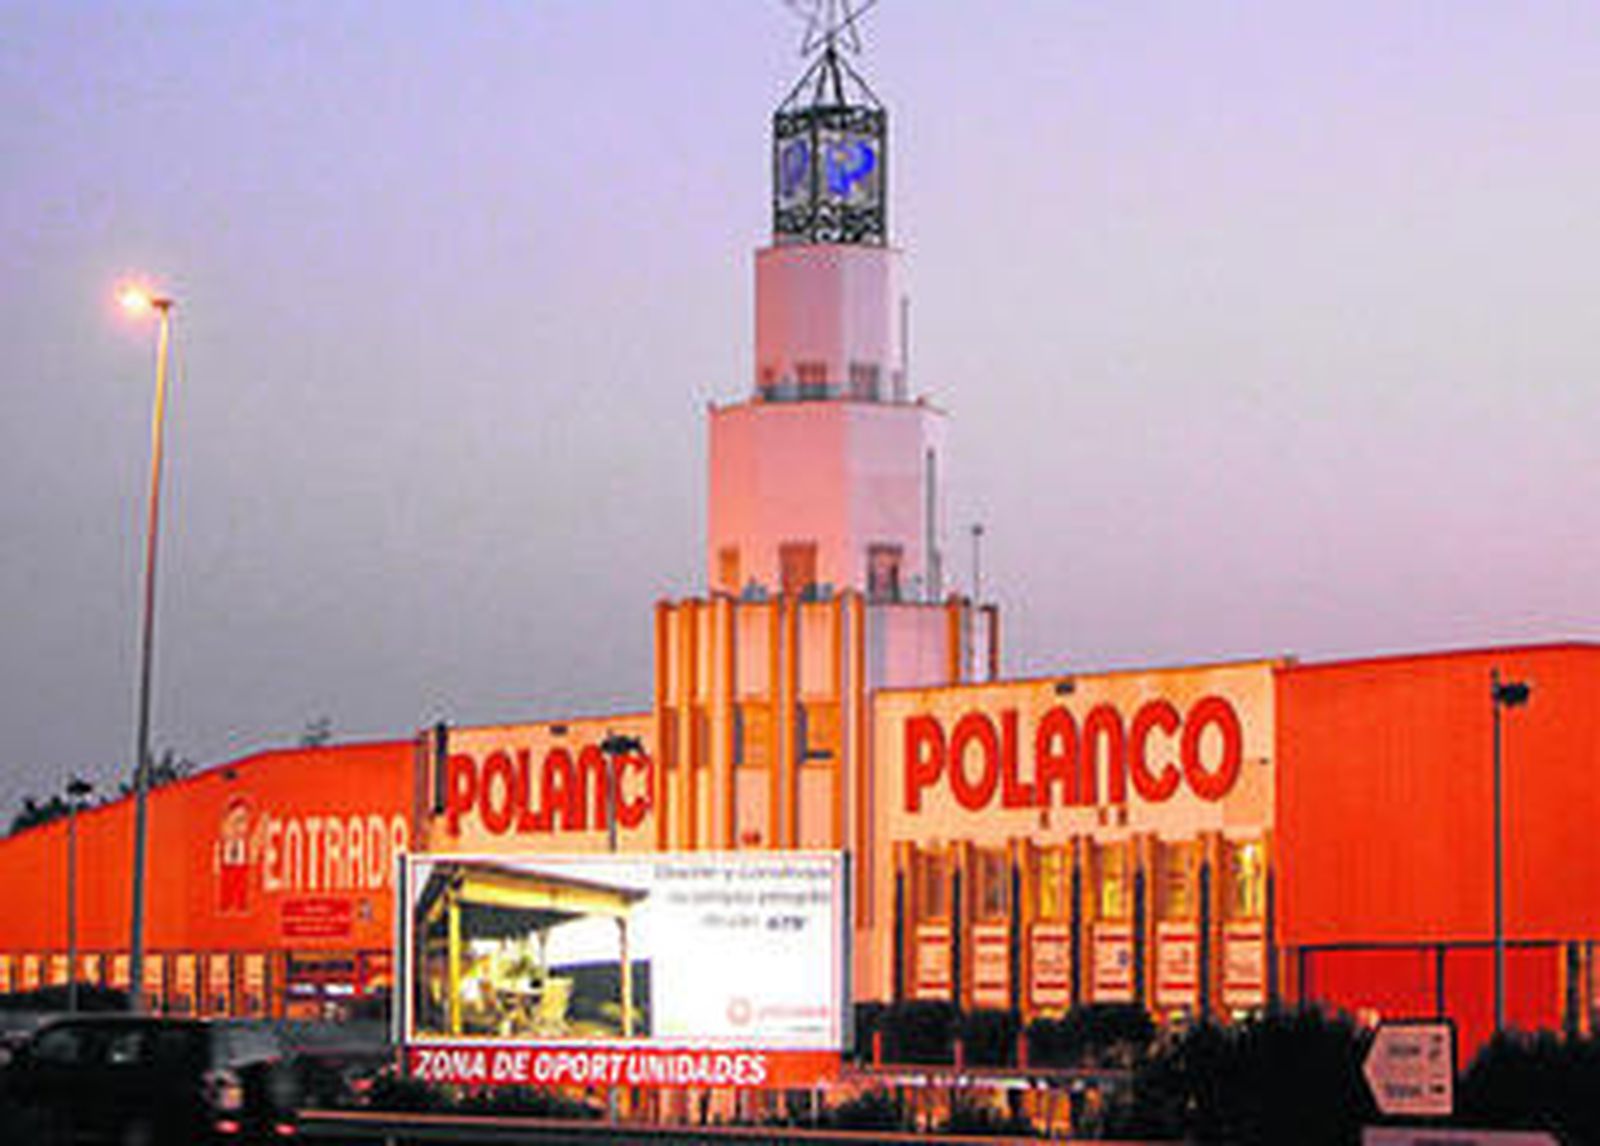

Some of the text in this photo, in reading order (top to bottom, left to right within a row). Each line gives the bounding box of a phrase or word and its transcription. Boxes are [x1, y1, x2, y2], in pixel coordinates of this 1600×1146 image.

[446, 744, 654, 837] POLANC
[904, 695, 1242, 812] POLANCO
[263, 813, 408, 893] ENTRADA
[412, 1050, 768, 1085] ZONA DE OPORTUNIDADES
